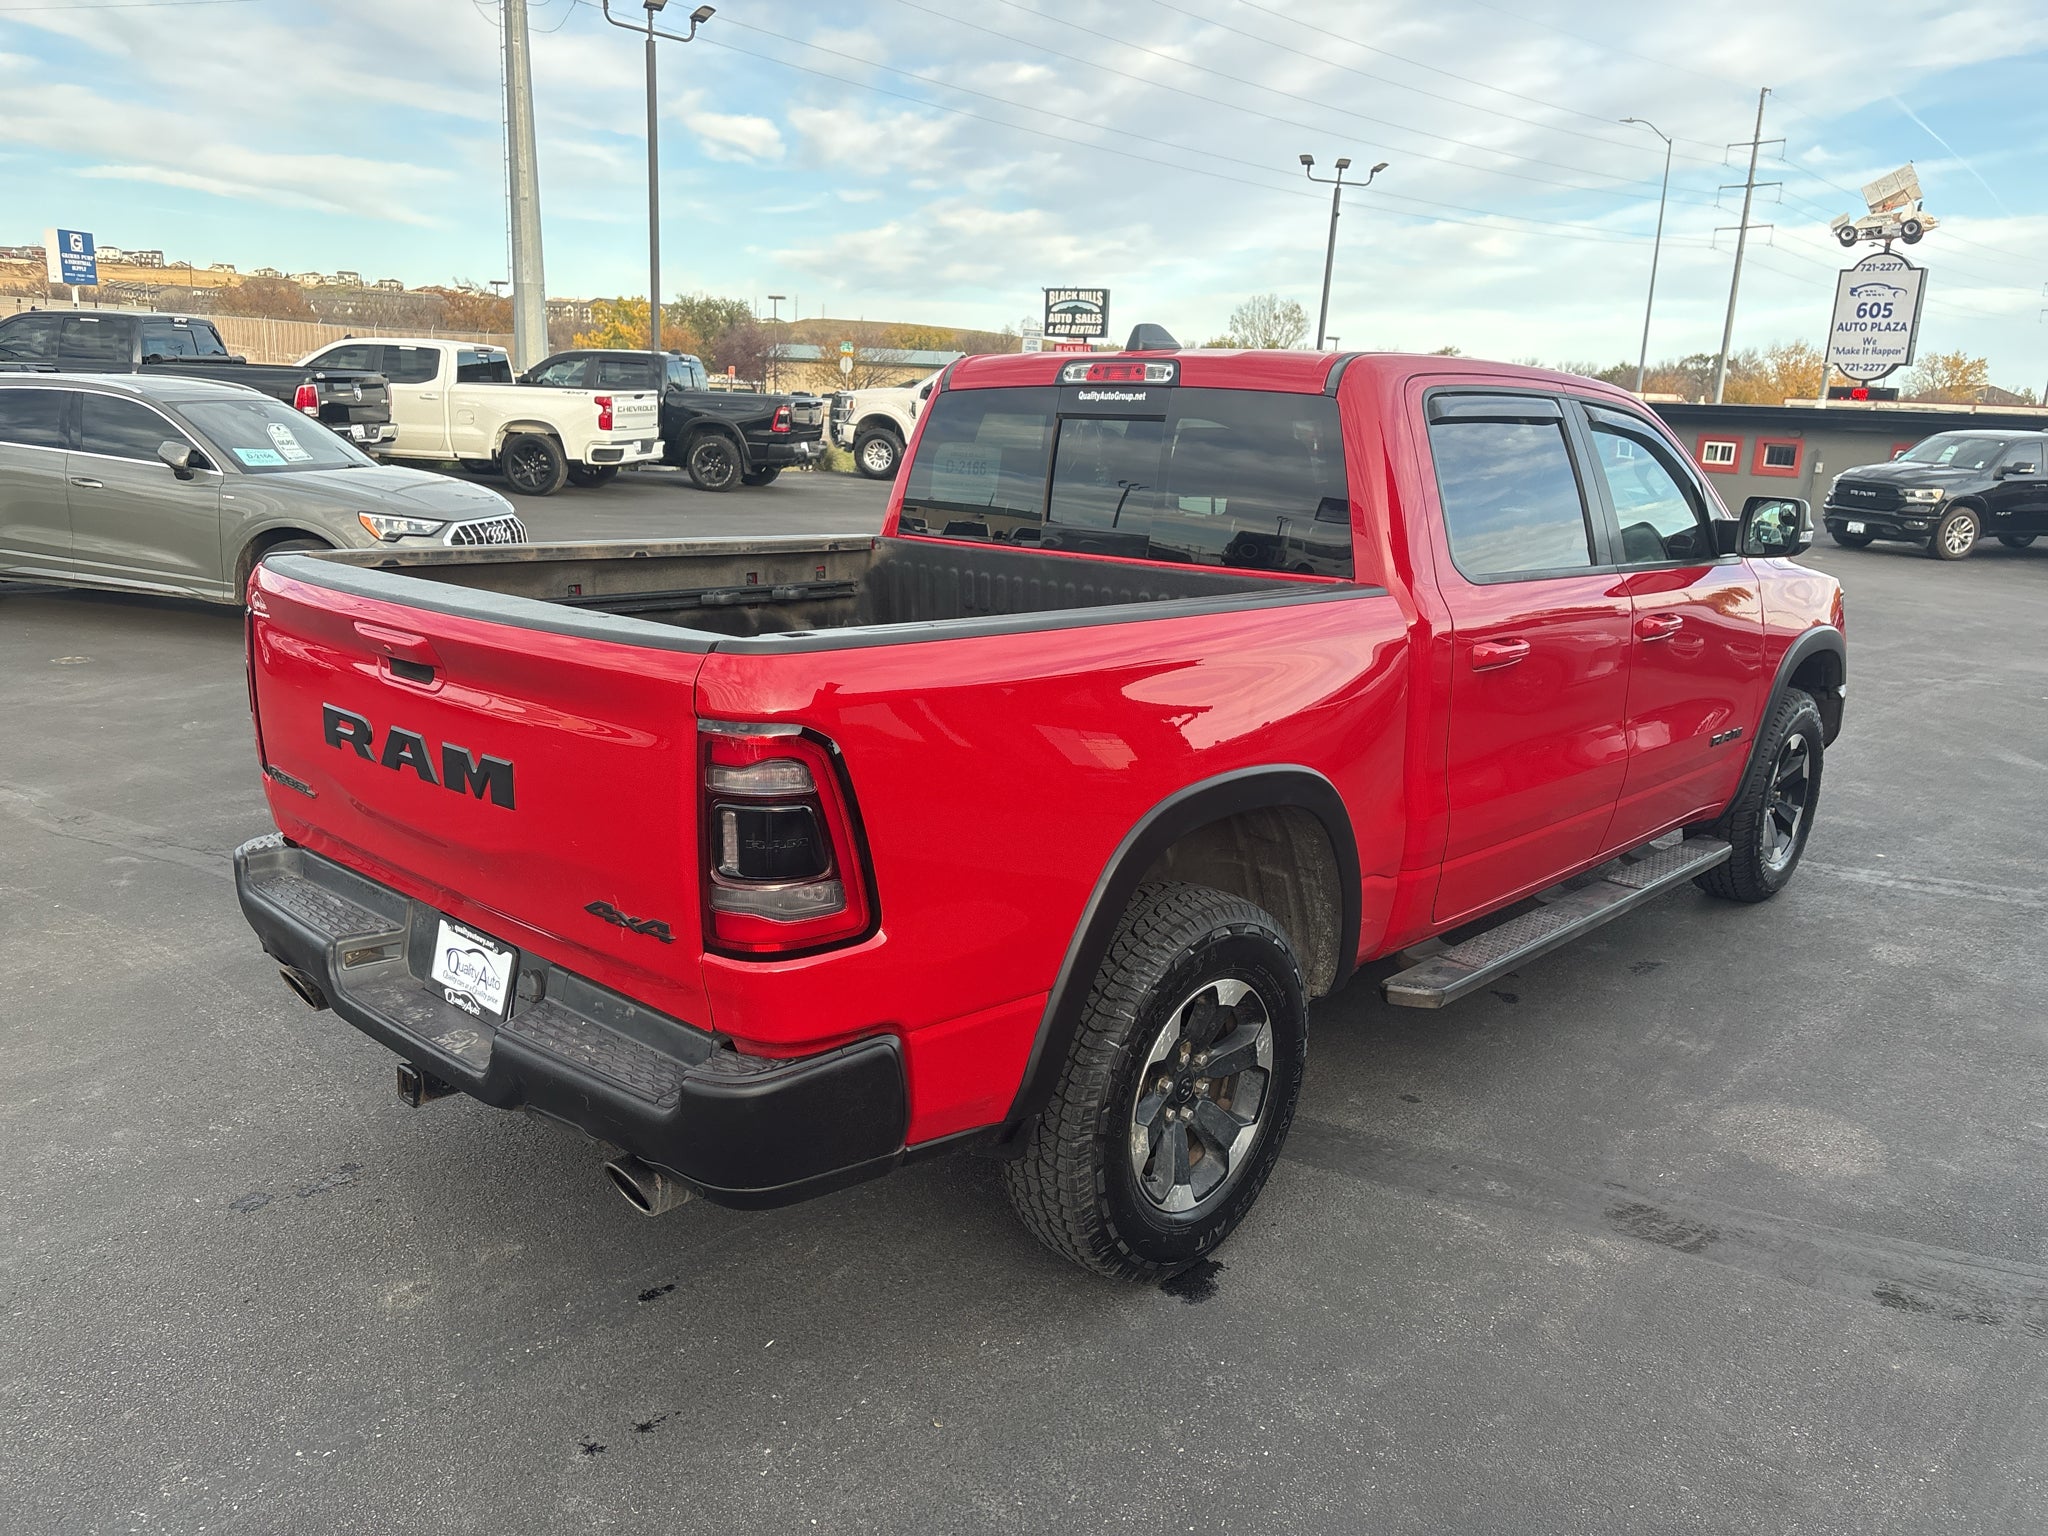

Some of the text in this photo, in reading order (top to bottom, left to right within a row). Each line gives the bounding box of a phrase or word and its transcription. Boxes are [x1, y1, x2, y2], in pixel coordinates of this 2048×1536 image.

[1860, 263, 1904, 272] 721-2277
[1048, 290, 1103, 306] BLACK HILLS
[1856, 302, 1893, 319] 605
[1048, 313, 1103, 324] AUTO SALES
[1047, 324, 1102, 335] & CAR RENTALS
[1836, 322, 1908, 332] AUTO PLAZA
[1862, 337, 1877, 346] We
[1844, 362, 1887, 372] 721-2277
[1078, 390, 1147, 402] QualityAutoGroup.net
[617, 404, 657, 413] CHEVROLET
[946, 460, 987, 476] D-2166
[322, 702, 517, 811] RAM
